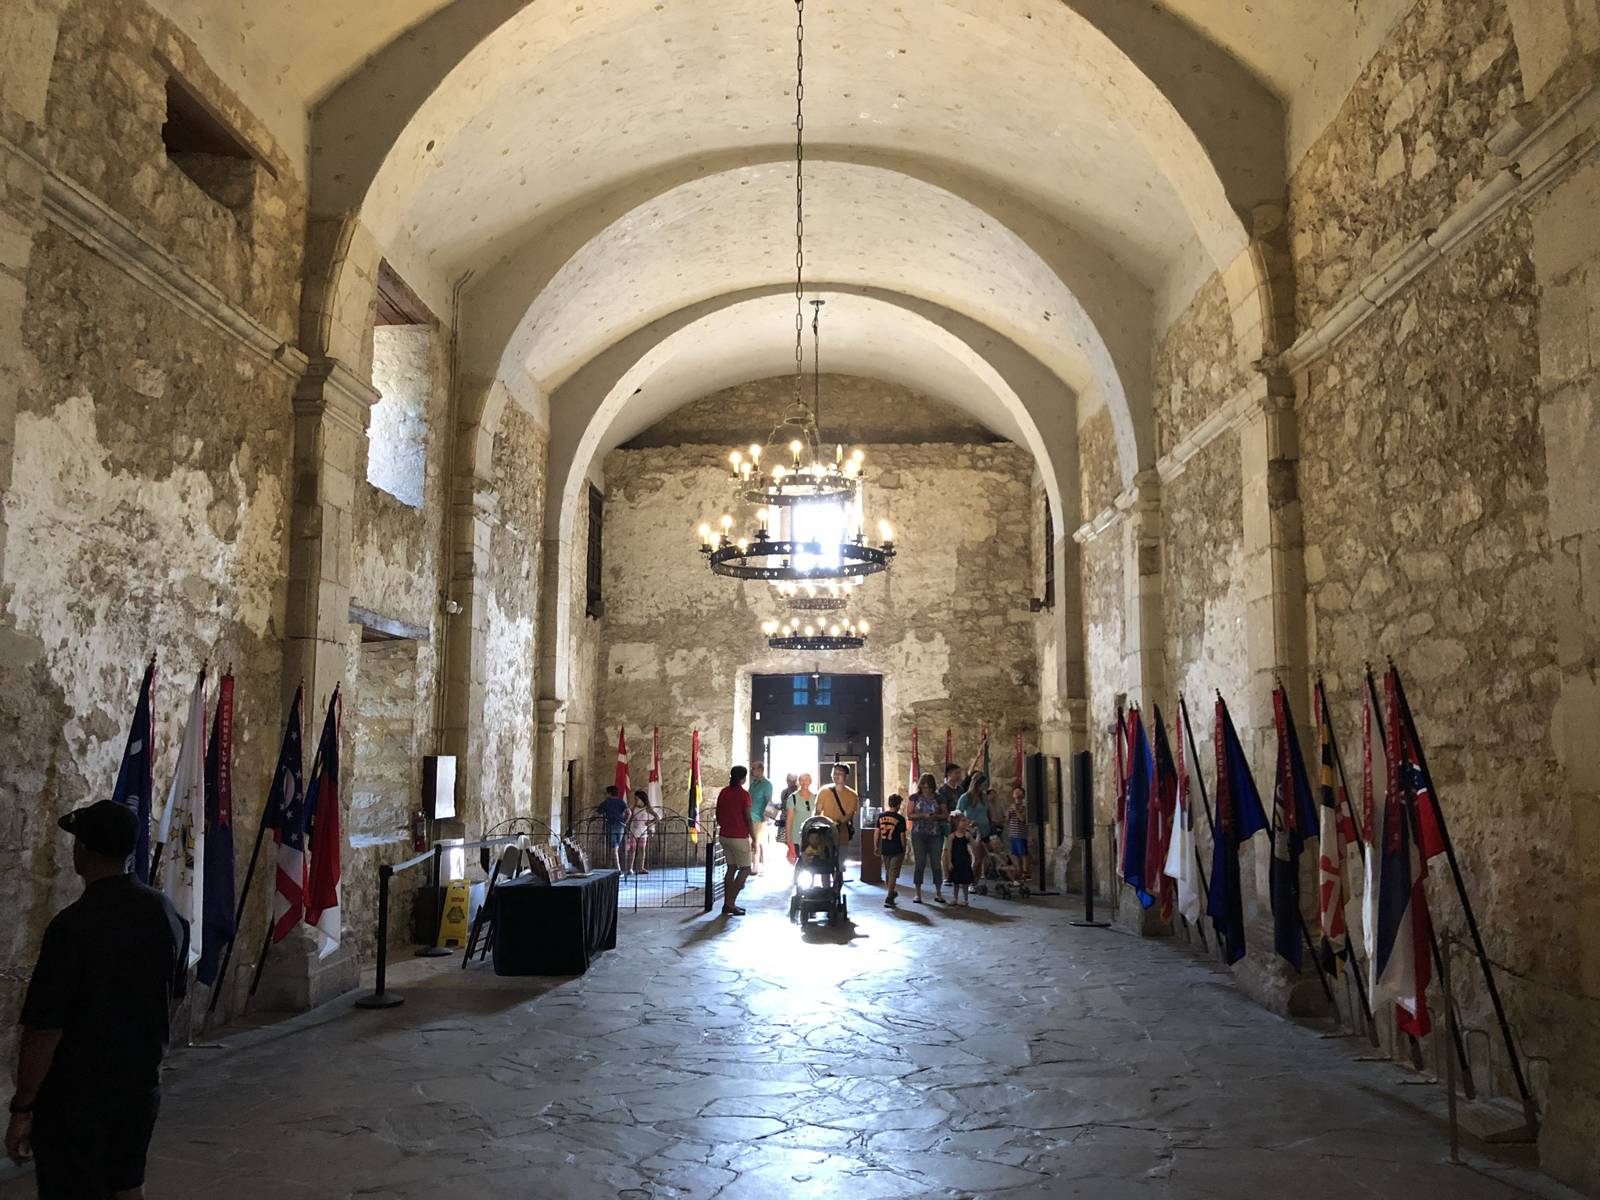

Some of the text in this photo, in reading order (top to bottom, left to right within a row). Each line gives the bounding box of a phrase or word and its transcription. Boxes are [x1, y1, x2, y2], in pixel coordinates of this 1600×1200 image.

[808, 722, 824, 734] EXIT
[220, 704, 230, 793] PENNSYLVANIA
[880, 824, 896, 841] 27
